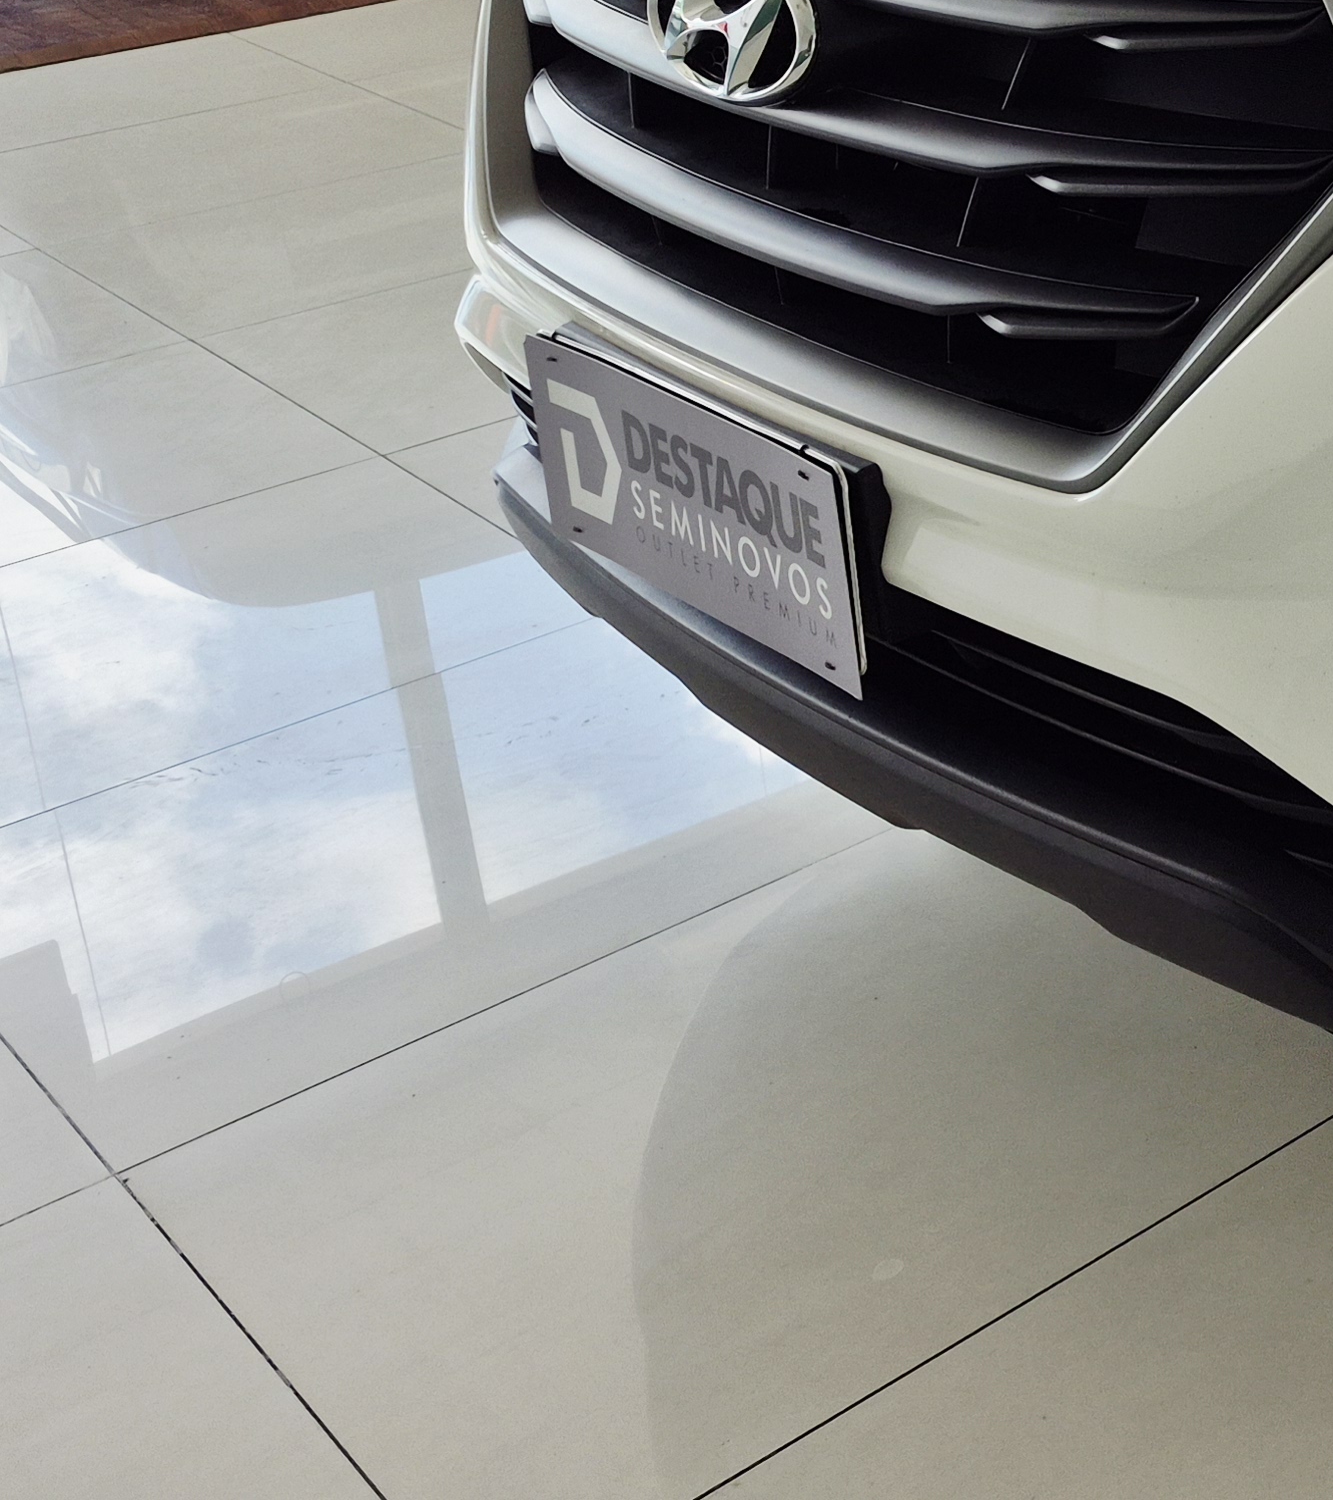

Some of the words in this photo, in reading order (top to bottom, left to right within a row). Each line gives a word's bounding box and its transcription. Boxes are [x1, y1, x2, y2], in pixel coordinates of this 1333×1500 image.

[621, 409, 827, 569] DESTAQUE
[630, 479, 833, 620] SEMINOVOS
[635, 525, 715, 581] OUTLET
[733, 575, 839, 649] PREMIUM
